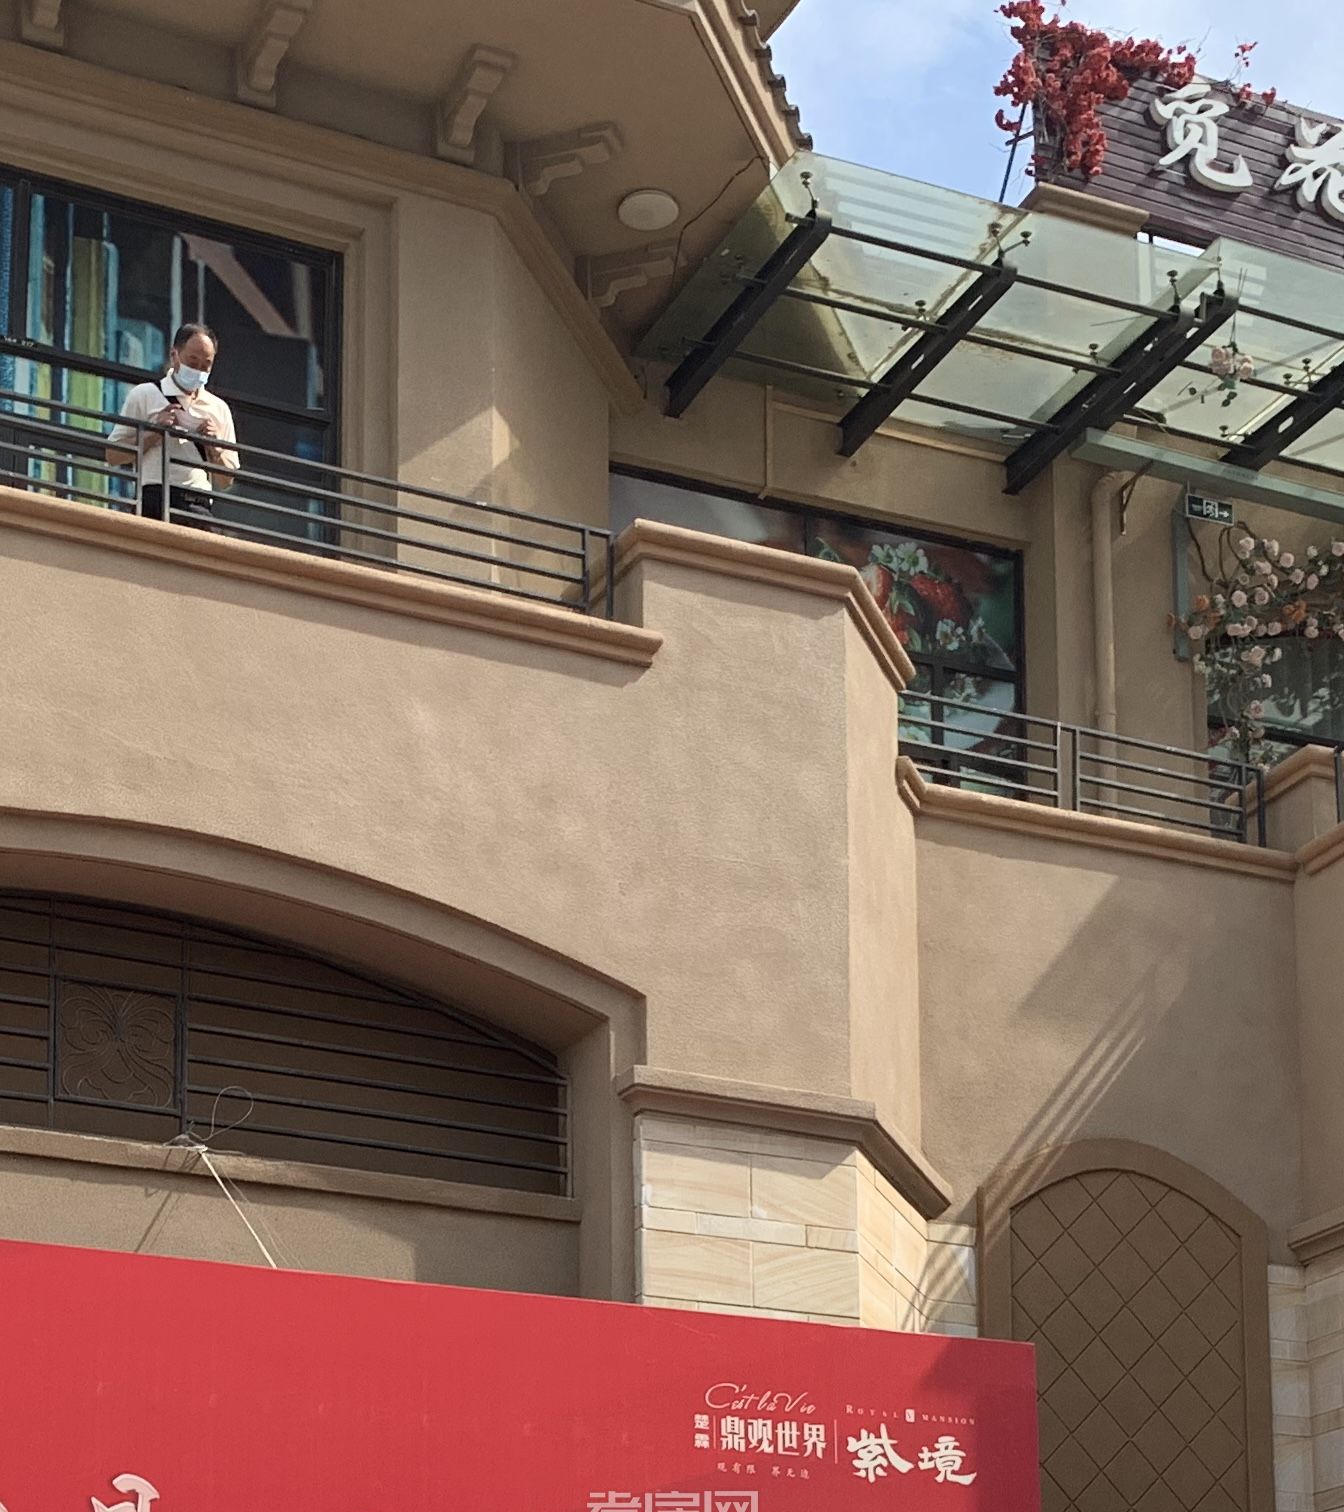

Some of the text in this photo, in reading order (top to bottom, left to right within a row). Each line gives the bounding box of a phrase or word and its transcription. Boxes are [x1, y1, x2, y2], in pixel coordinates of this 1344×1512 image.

[720, 1415, 827, 1460] 鼎观世界
[921, 1413, 975, 1425] MANSION
[846, 1423, 977, 1486] 紫境
